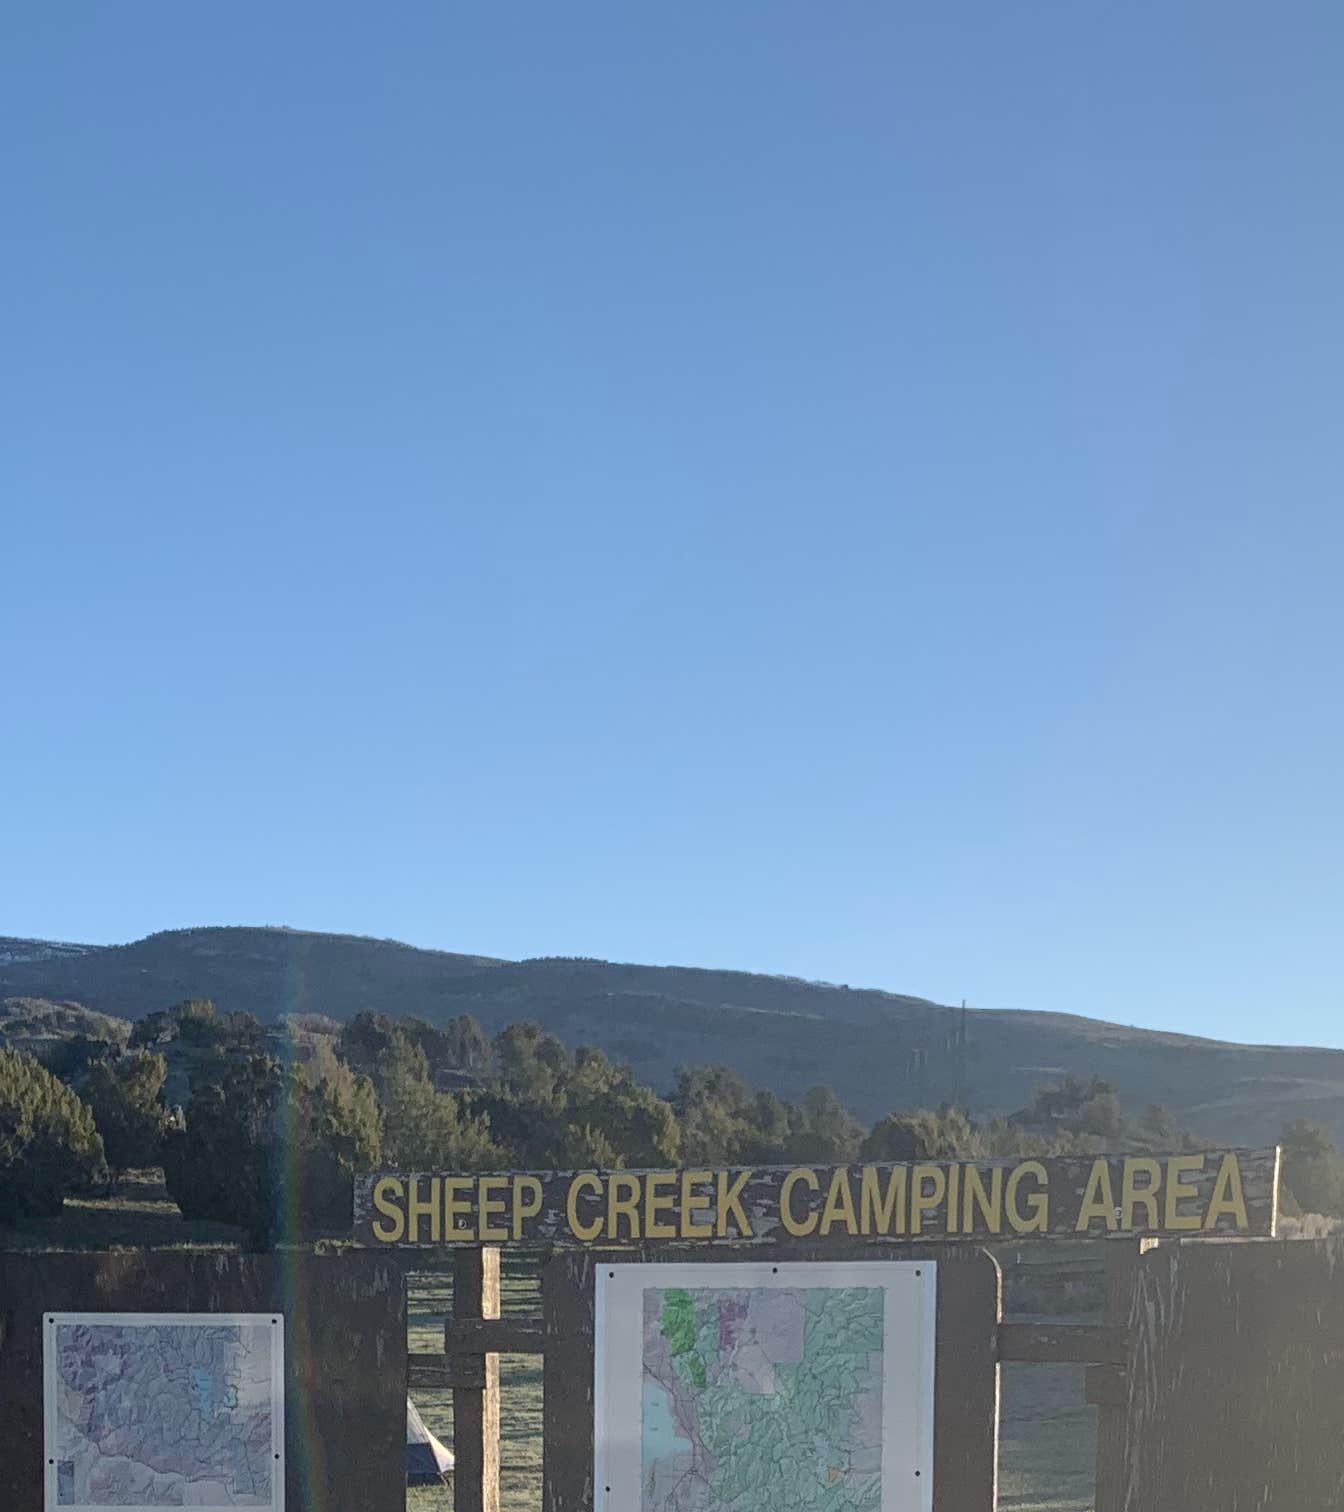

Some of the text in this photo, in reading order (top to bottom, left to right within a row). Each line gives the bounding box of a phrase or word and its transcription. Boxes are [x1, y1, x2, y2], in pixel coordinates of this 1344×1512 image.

[371, 1152, 1250, 1243] SHEEP CREEK CAMPING AREA
